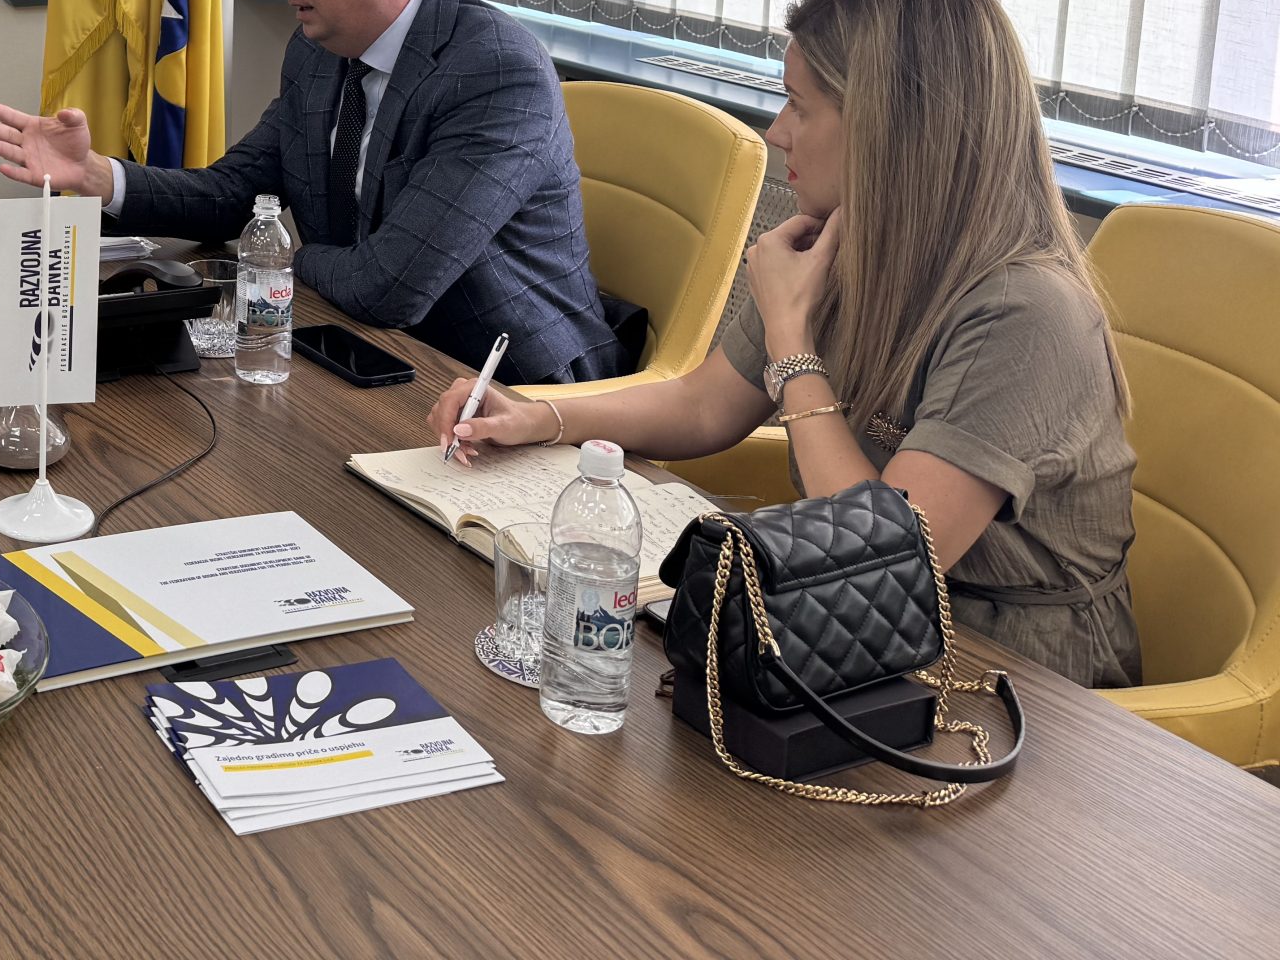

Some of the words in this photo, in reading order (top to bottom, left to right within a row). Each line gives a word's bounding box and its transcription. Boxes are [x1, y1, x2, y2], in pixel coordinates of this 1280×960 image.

[19, 228, 42, 309] RAZVOJNA
[48, 248, 63, 308] BANKA
[304, 586, 352, 599] RAZVOJNA
[311, 593, 347, 605] BANKA
[419, 738, 456, 750] RAZVOJNA
[423, 745, 452, 755] BANKA
[215, 754, 254, 763] Zajedno
[255, 751, 295, 761] gradimo
[296, 748, 320, 758] priče
[328, 741, 366, 752] uspjehu
